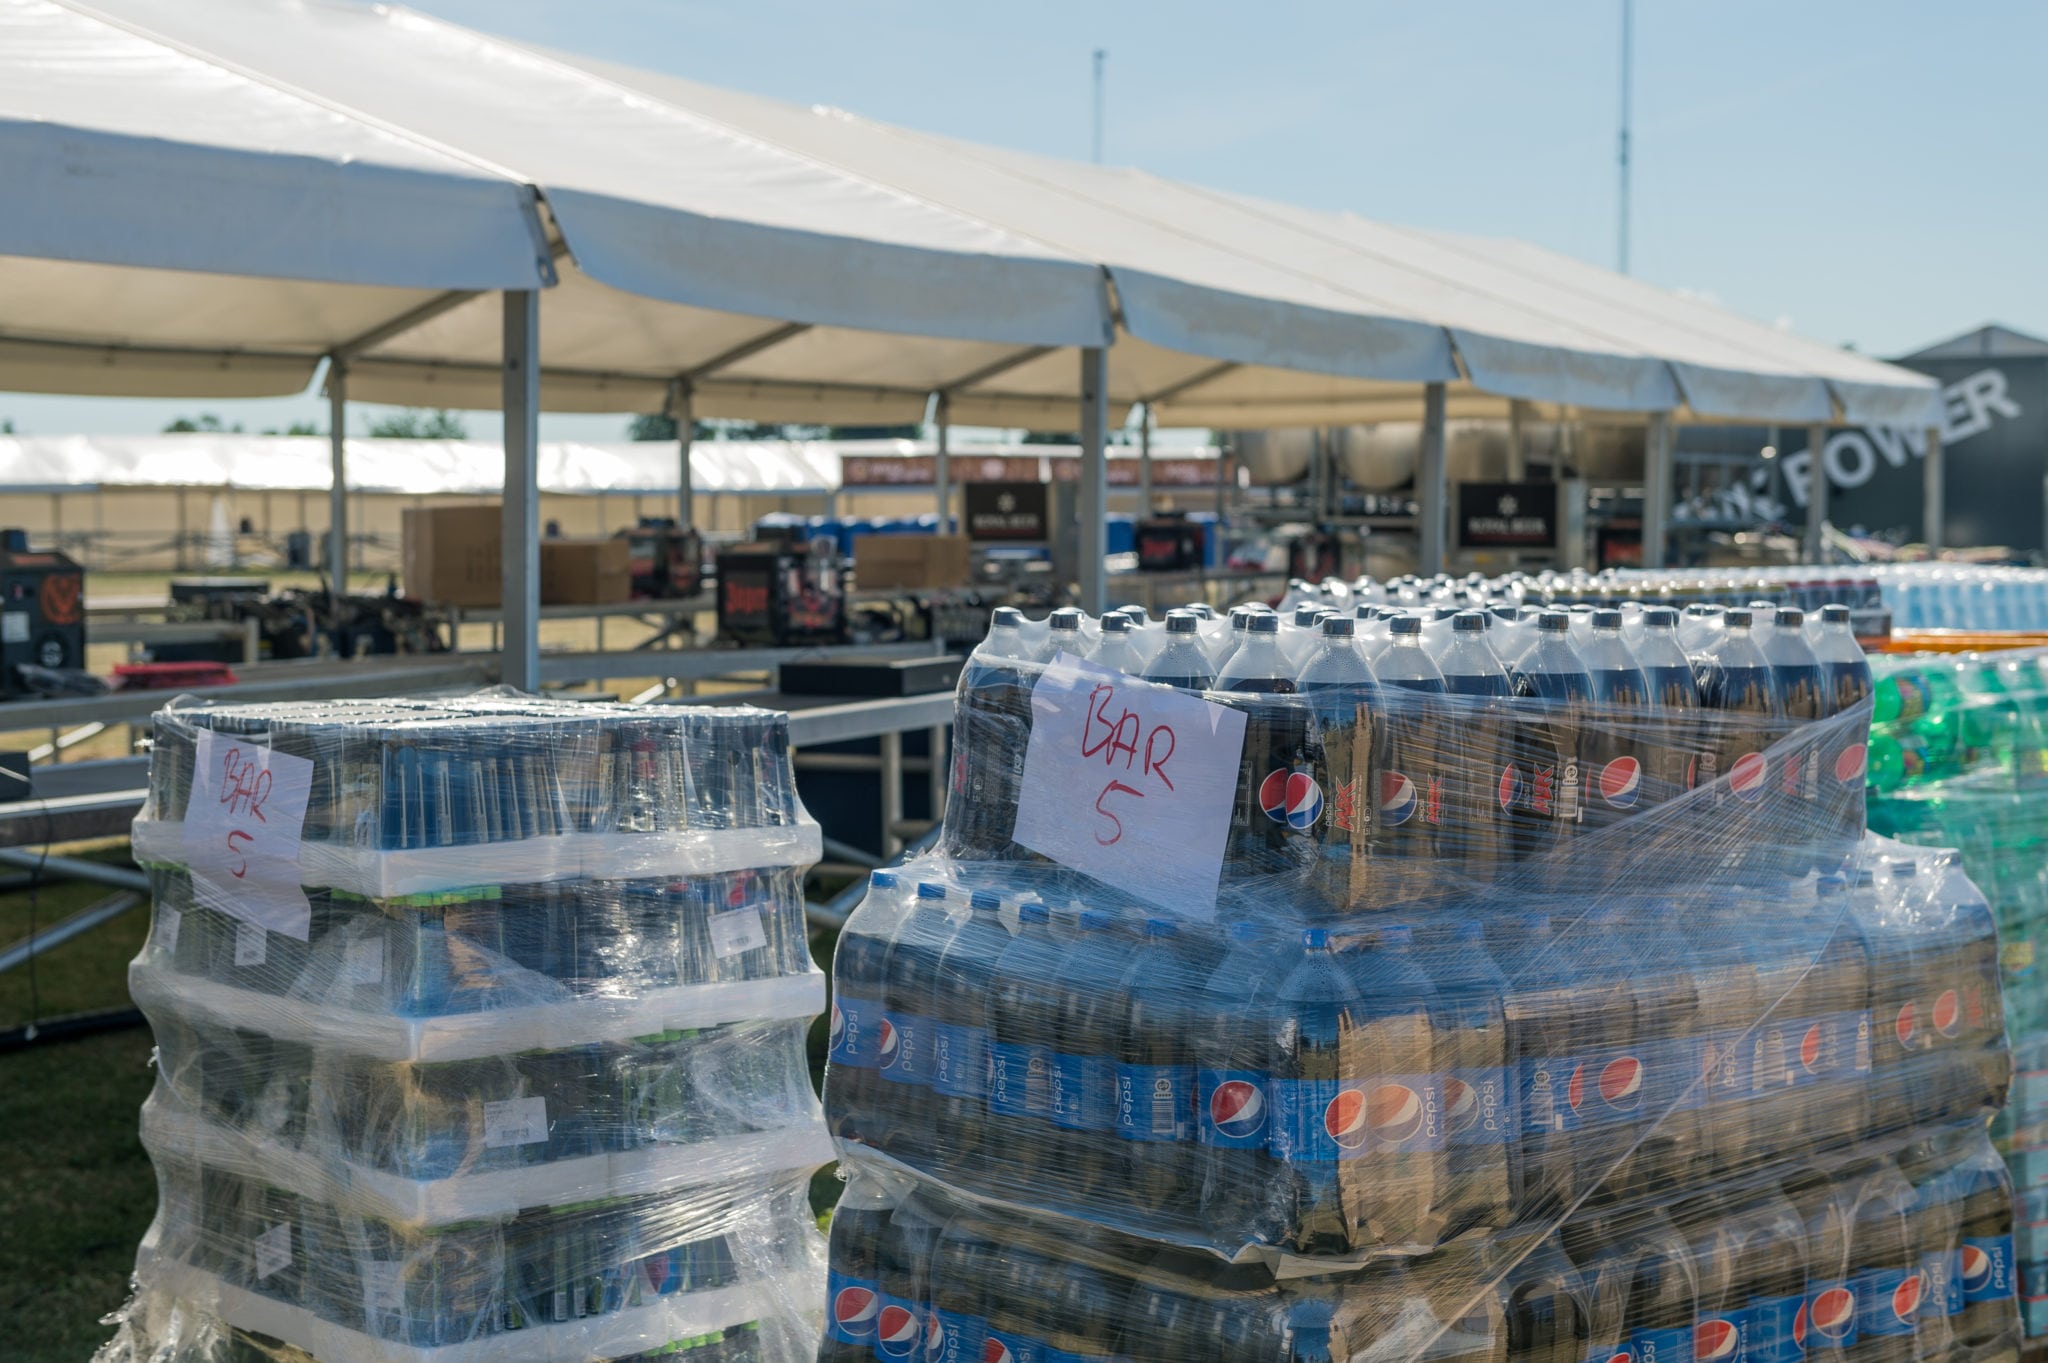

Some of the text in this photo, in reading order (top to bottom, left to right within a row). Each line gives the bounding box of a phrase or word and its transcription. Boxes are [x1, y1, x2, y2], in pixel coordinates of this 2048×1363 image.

[1082, 684, 1175, 791] BAR
[220, 748, 272, 823] BAR
[1334, 776, 1357, 832] MAX
[1427, 772, 1443, 825] MAX
[1532, 761, 1555, 816] MAX
[1094, 780, 1144, 846] 5
[1325, 802, 1334, 827] pepsi
[846, 1009, 859, 1055] pepsi
[901, 1025, 916, 1072] pepsi
[939, 1035, 951, 1083] pepsi
[997, 1055, 1009, 1103] pepsi
[1054, 1064, 1065, 1115] pepsi
[1121, 1075, 1135, 1127] pepsi
[1424, 1086, 1438, 1138] pepsi
[1480, 1081, 1499, 1132] pepsi
[1929, 1262, 1946, 1306] pepsi
[1993, 1246, 2007, 1290] pepsi
